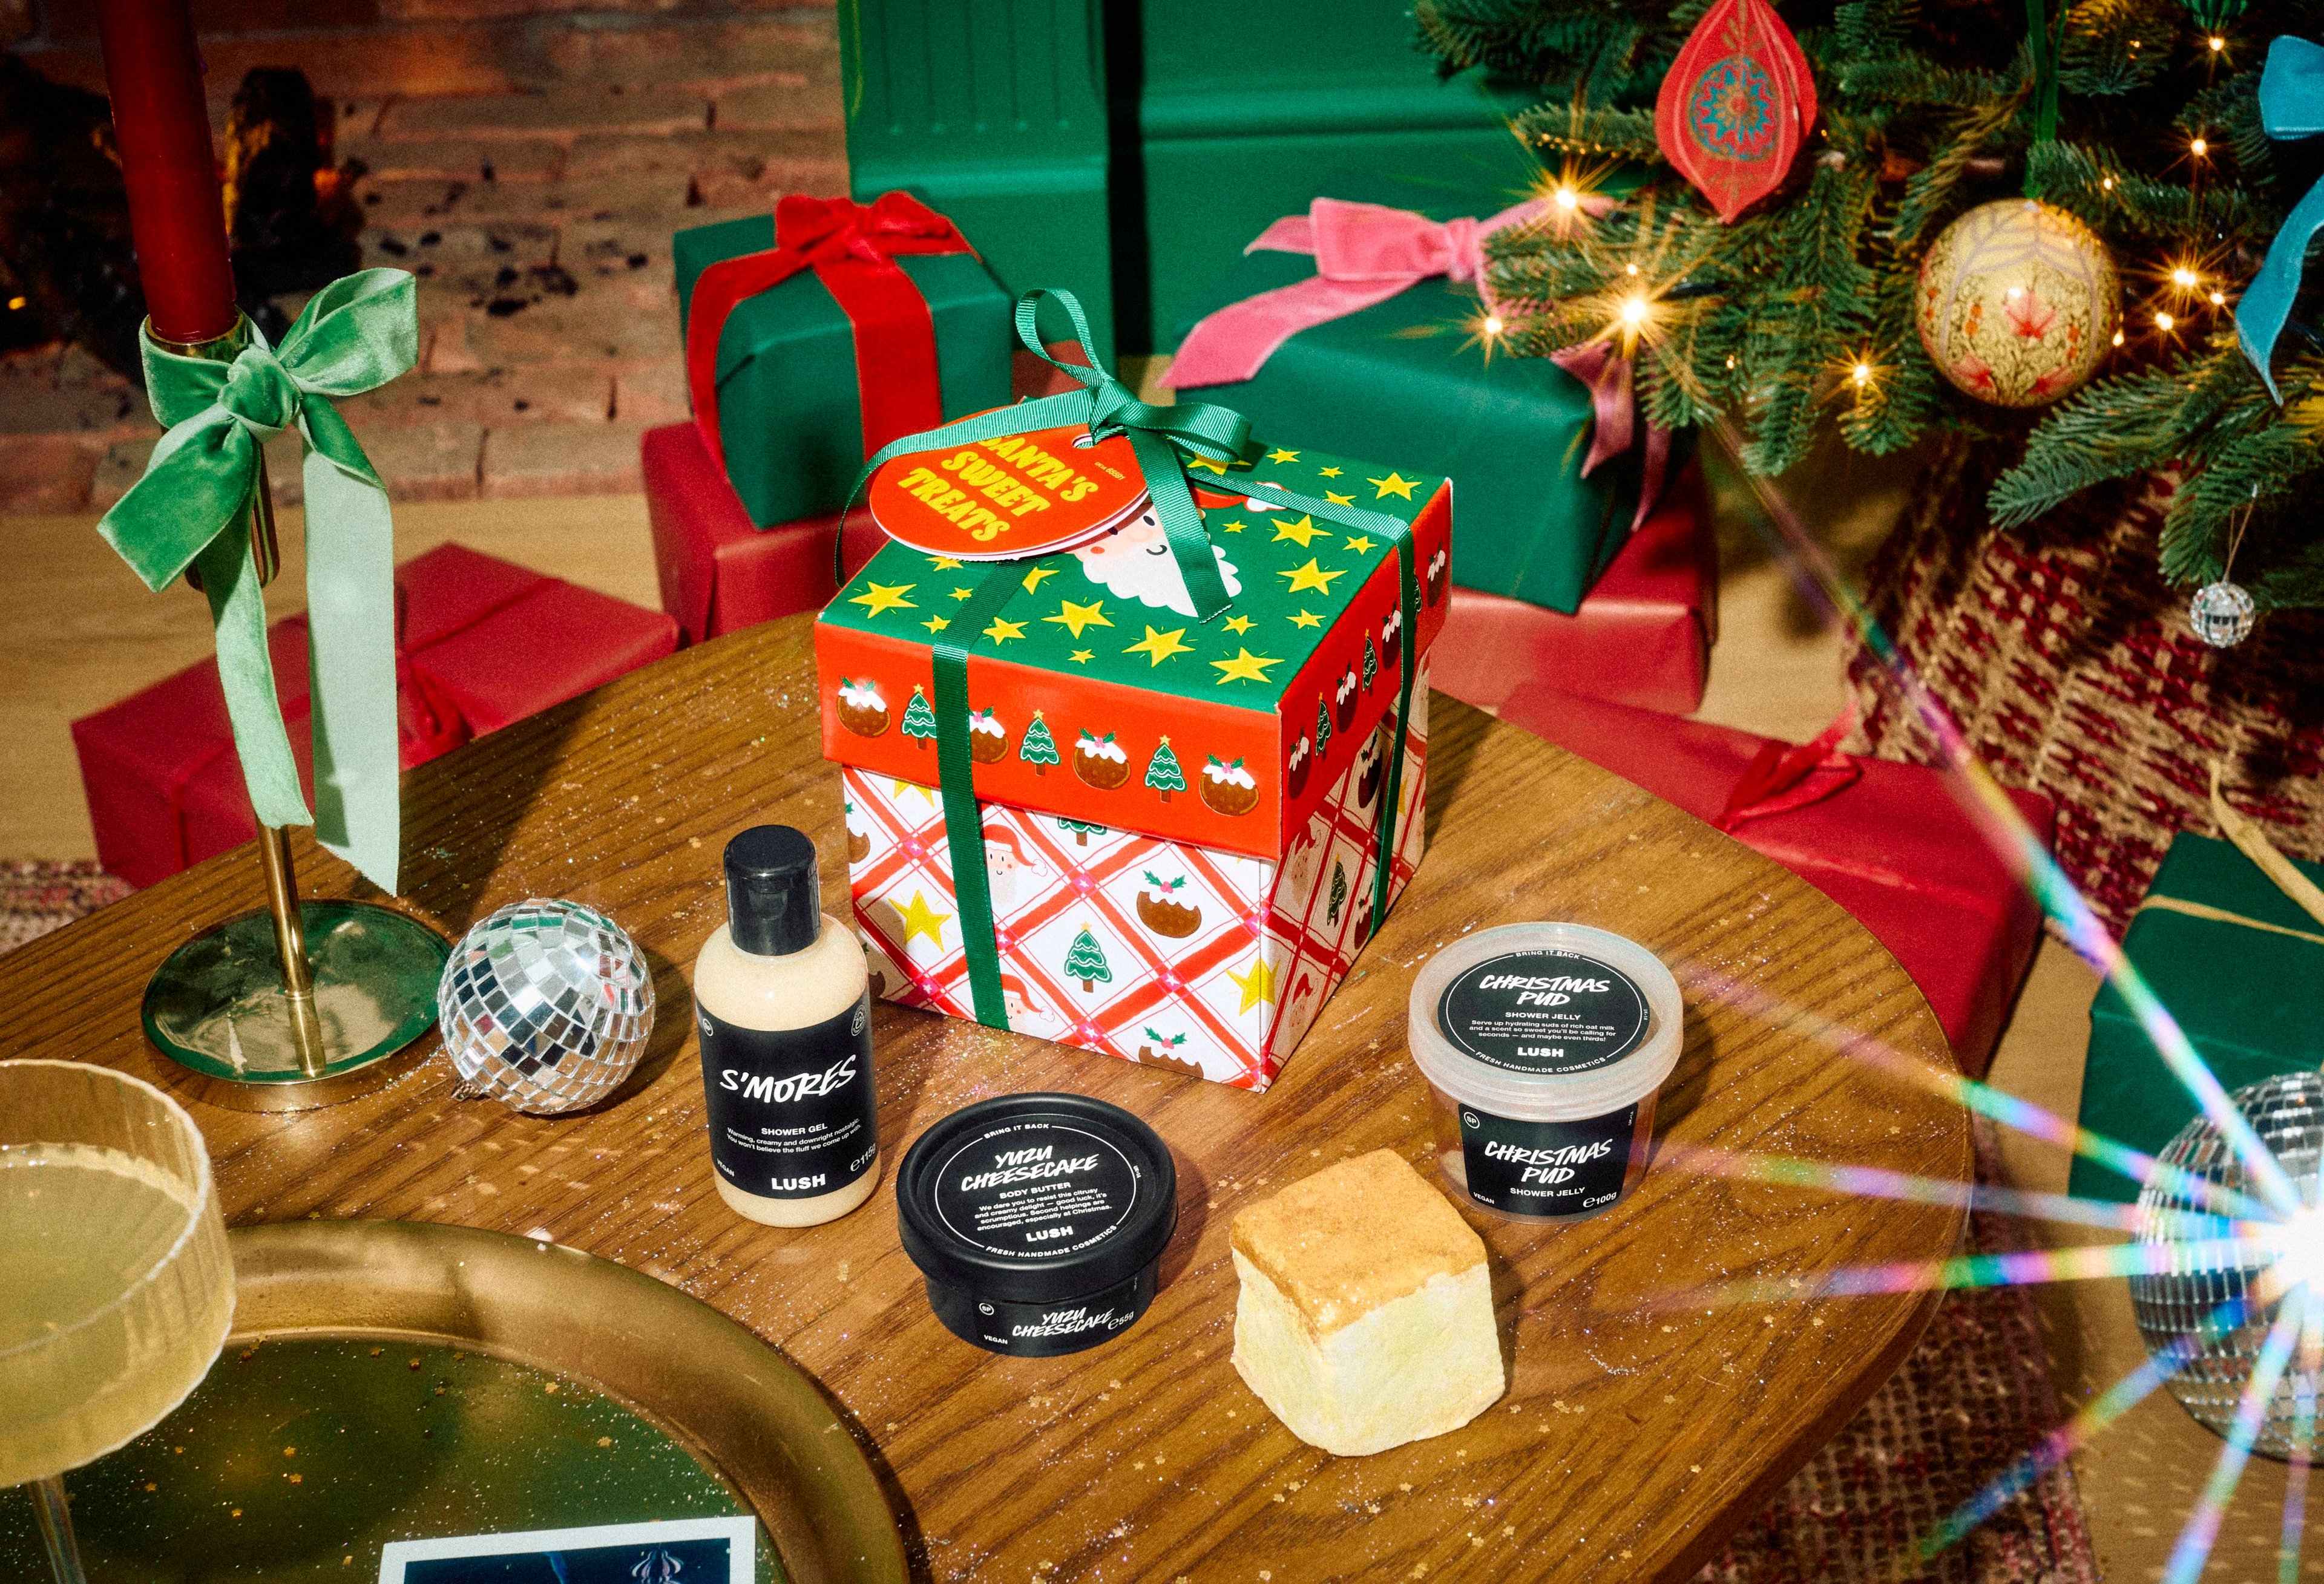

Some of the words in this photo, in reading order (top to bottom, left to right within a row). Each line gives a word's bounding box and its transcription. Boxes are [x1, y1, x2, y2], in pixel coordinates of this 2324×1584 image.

[941, 451, 1051, 517] SWEET
[898, 467, 1010, 541] TREATS
[1557, 951, 1580, 960] BACK
[1479, 975, 1610, 992] CHRISTMAS
[1516, 991, 1571, 1006] PUD
[1517, 1047, 1564, 1057] LUSH
[1475, 1052, 1502, 1065] FRESH
[1503, 1062, 1553, 1073] HANDMADE
[1556, 1057, 1606, 1072] COSMETICS
[720, 1055, 856, 1103] S'MORES
[727, 1127, 755, 1143] Warming,
[799, 1132, 833, 1145] downright
[835, 1118, 860, 1135] nostalgic.
[727, 1133, 737, 1143] You
[738, 1140, 755, 1149] won't
[822, 1137, 841, 1147] come
[850, 1124, 861, 1134] with.
[761, 1127, 806, 1136] SHOWER
[808, 1123, 828, 1133] GEL
[983, 1127, 1011, 1139] BRING
[995, 1145, 1052, 1168] YUZU
[1485, 1139, 1613, 1165] CHRISTMAS
[717, 1158, 735, 1177] VEGAN
[961, 1154, 1099, 1191] CHEESECAKE
[1521, 1167, 1575, 1183] PUD
[772, 1174, 826, 1190] LUSH
[999, 1189, 1028, 1199] BODY
[1031, 1182, 1071, 1194] BUTTER
[1473, 1192, 1494, 1204] VEGAN
[1510, 1188, 1554, 1197] SHOWER
[1557, 1187, 1585, 1196] JELLY
[977, 1219, 1024, 1231] encouraged,
[1025, 1213, 1062, 1222] especially
[1072, 1205, 1112, 1215] Christmas.
[980, 1213, 1028, 1224] scrumptious.
[1029, 1206, 1058, 1216] Second
[1060, 1202, 1091, 1210] helpings
[991, 1208, 1017, 1216] creamy
[1019, 1202, 1045, 1211] delight
[985, 1246, 1015, 1257] FRESH
[1017, 1247, 1070, 1257] HANDMADE
[1072, 1225, 1117, 1251] COSMETICS
[1026, 1226, 1074, 1242] LUSH
[1012, 1308, 1114, 1337] CHEESECAKE
[1042, 1307, 1087, 1326] YUZU
[983, 1334, 1008, 1344] VEGAN
